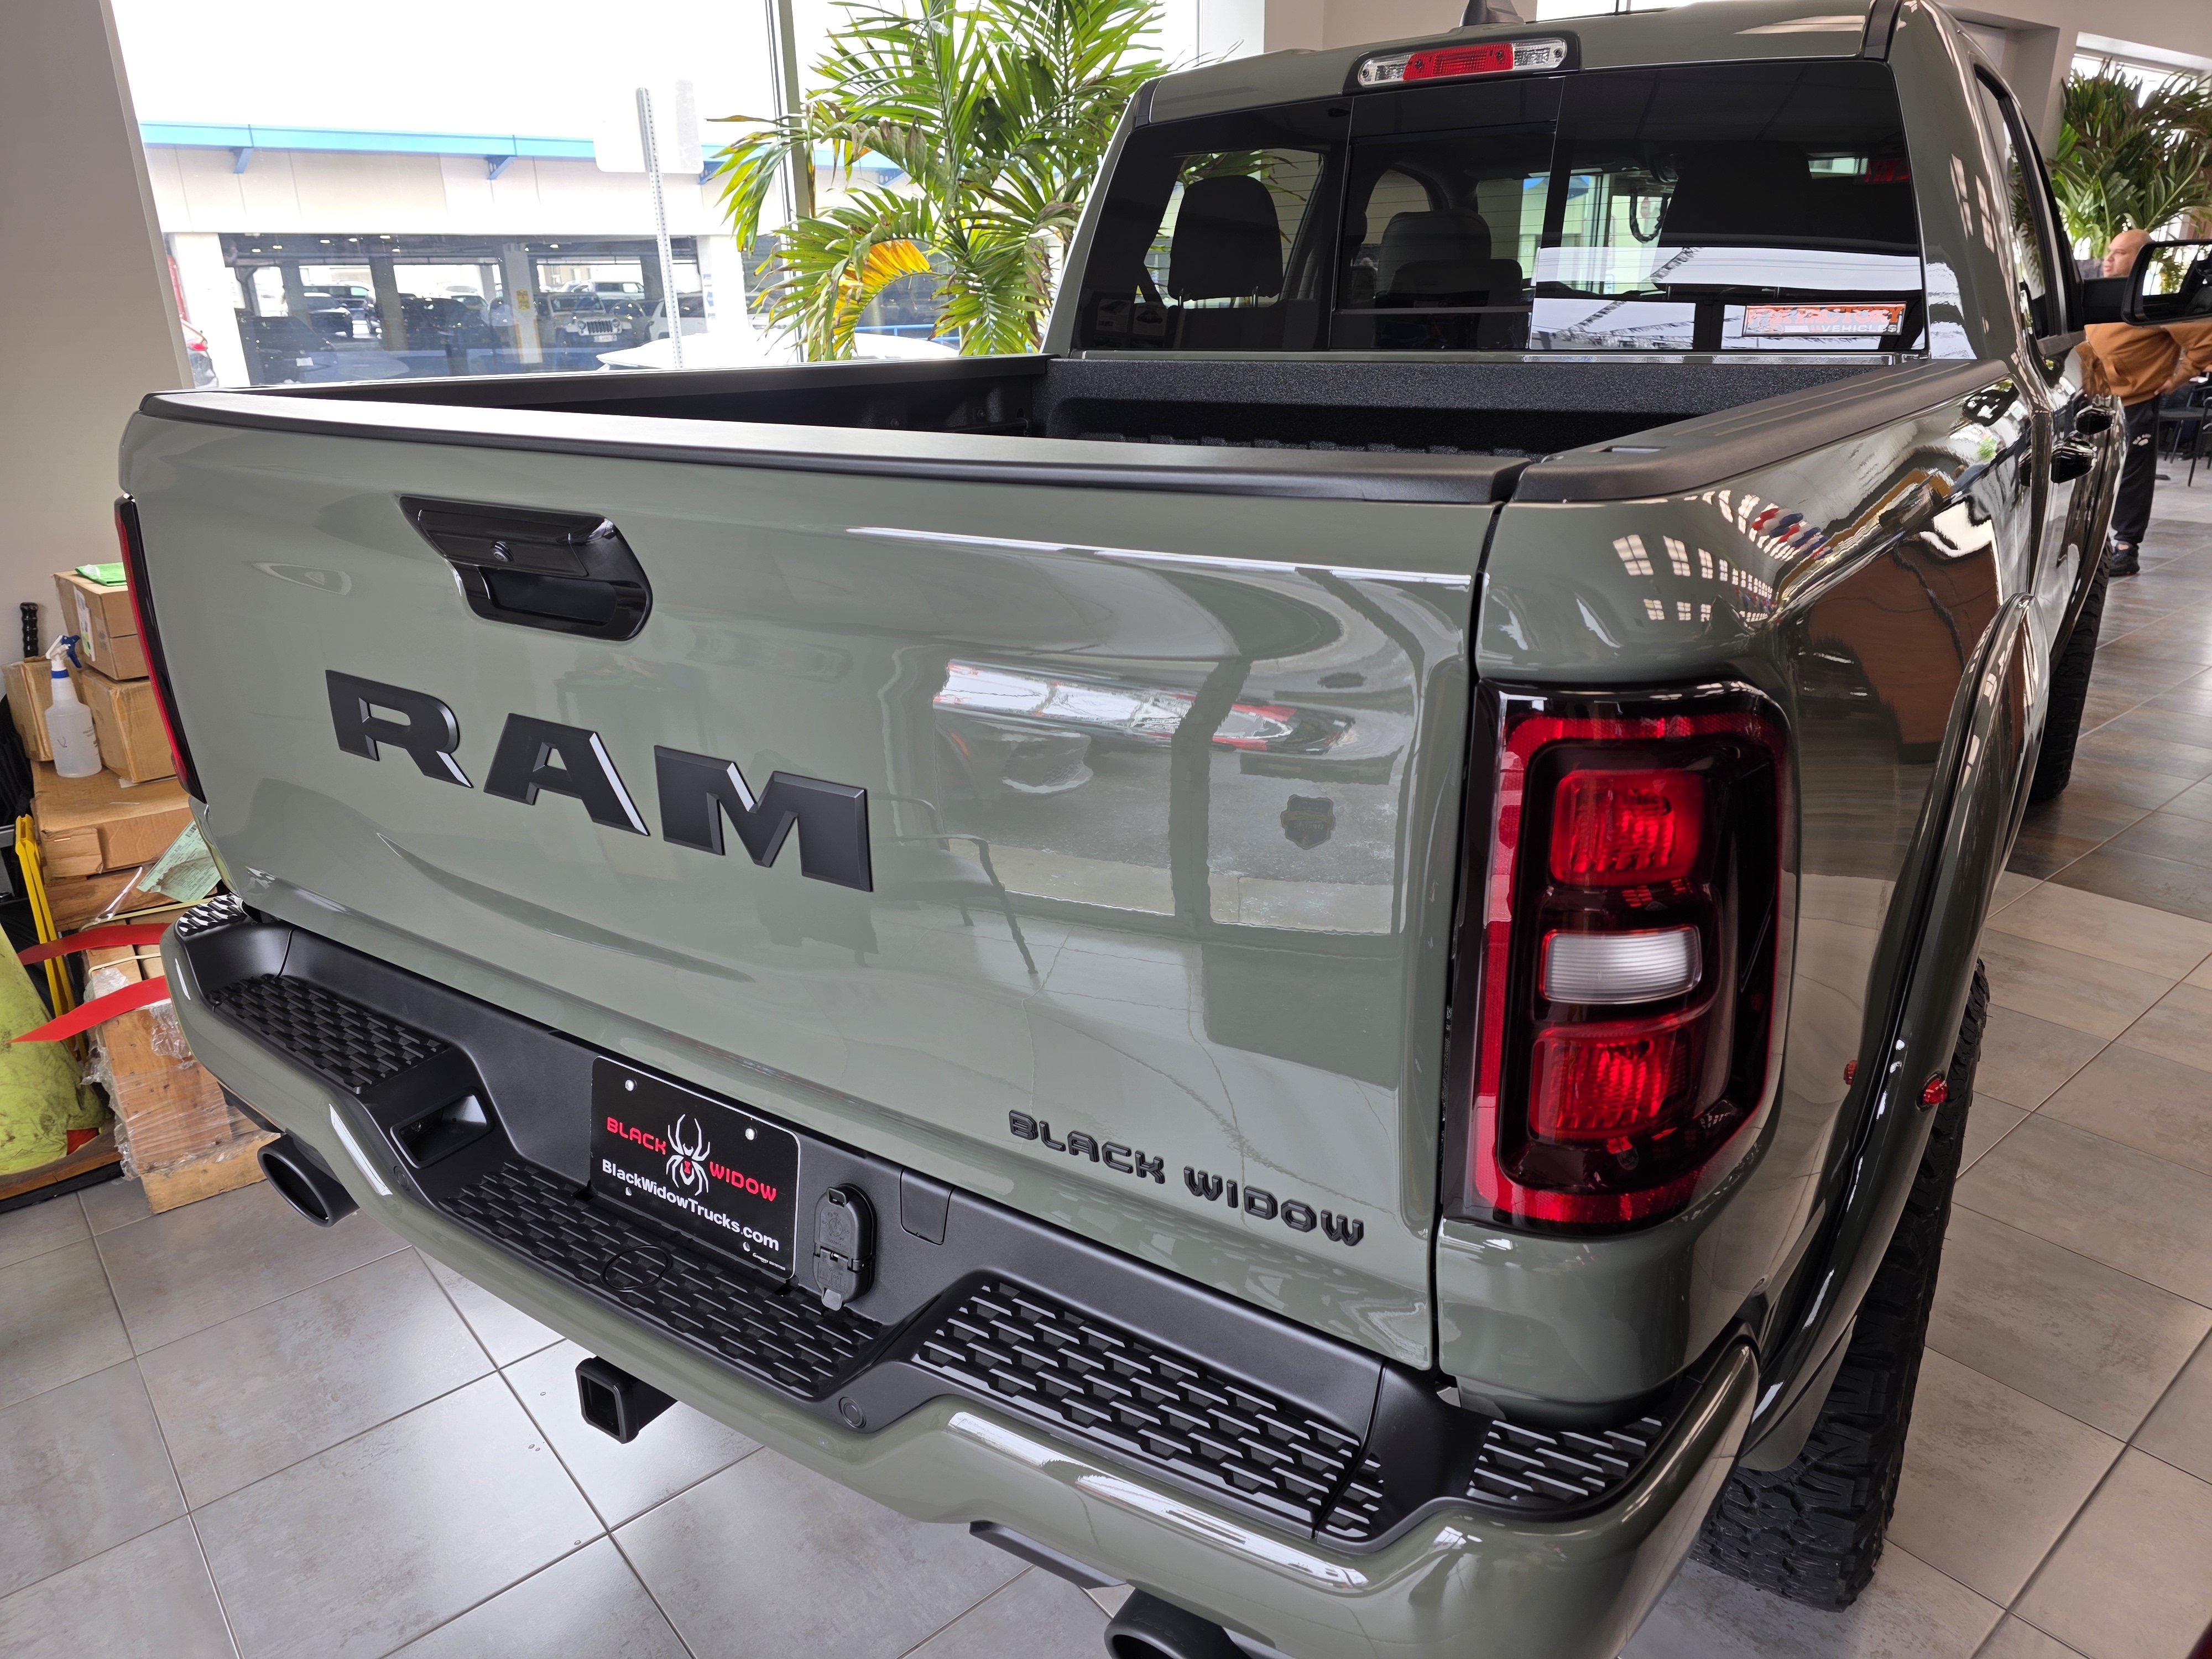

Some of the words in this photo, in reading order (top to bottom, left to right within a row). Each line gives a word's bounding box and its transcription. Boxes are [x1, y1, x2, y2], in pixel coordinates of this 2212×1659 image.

[1796, 306, 1904, 325] FACTORY
[1820, 324, 1897, 333] VEHICLES
[326, 670, 873, 893] RAM
[607, 1117, 666, 1155] BLACK
[709, 1161, 776, 1202] WIDOW
[1009, 1109, 1165, 1185] BLACK
[1183, 1165, 1364, 1246] WIDOW
[602, 1159, 780, 1251] BlackWidowTrucks.com
